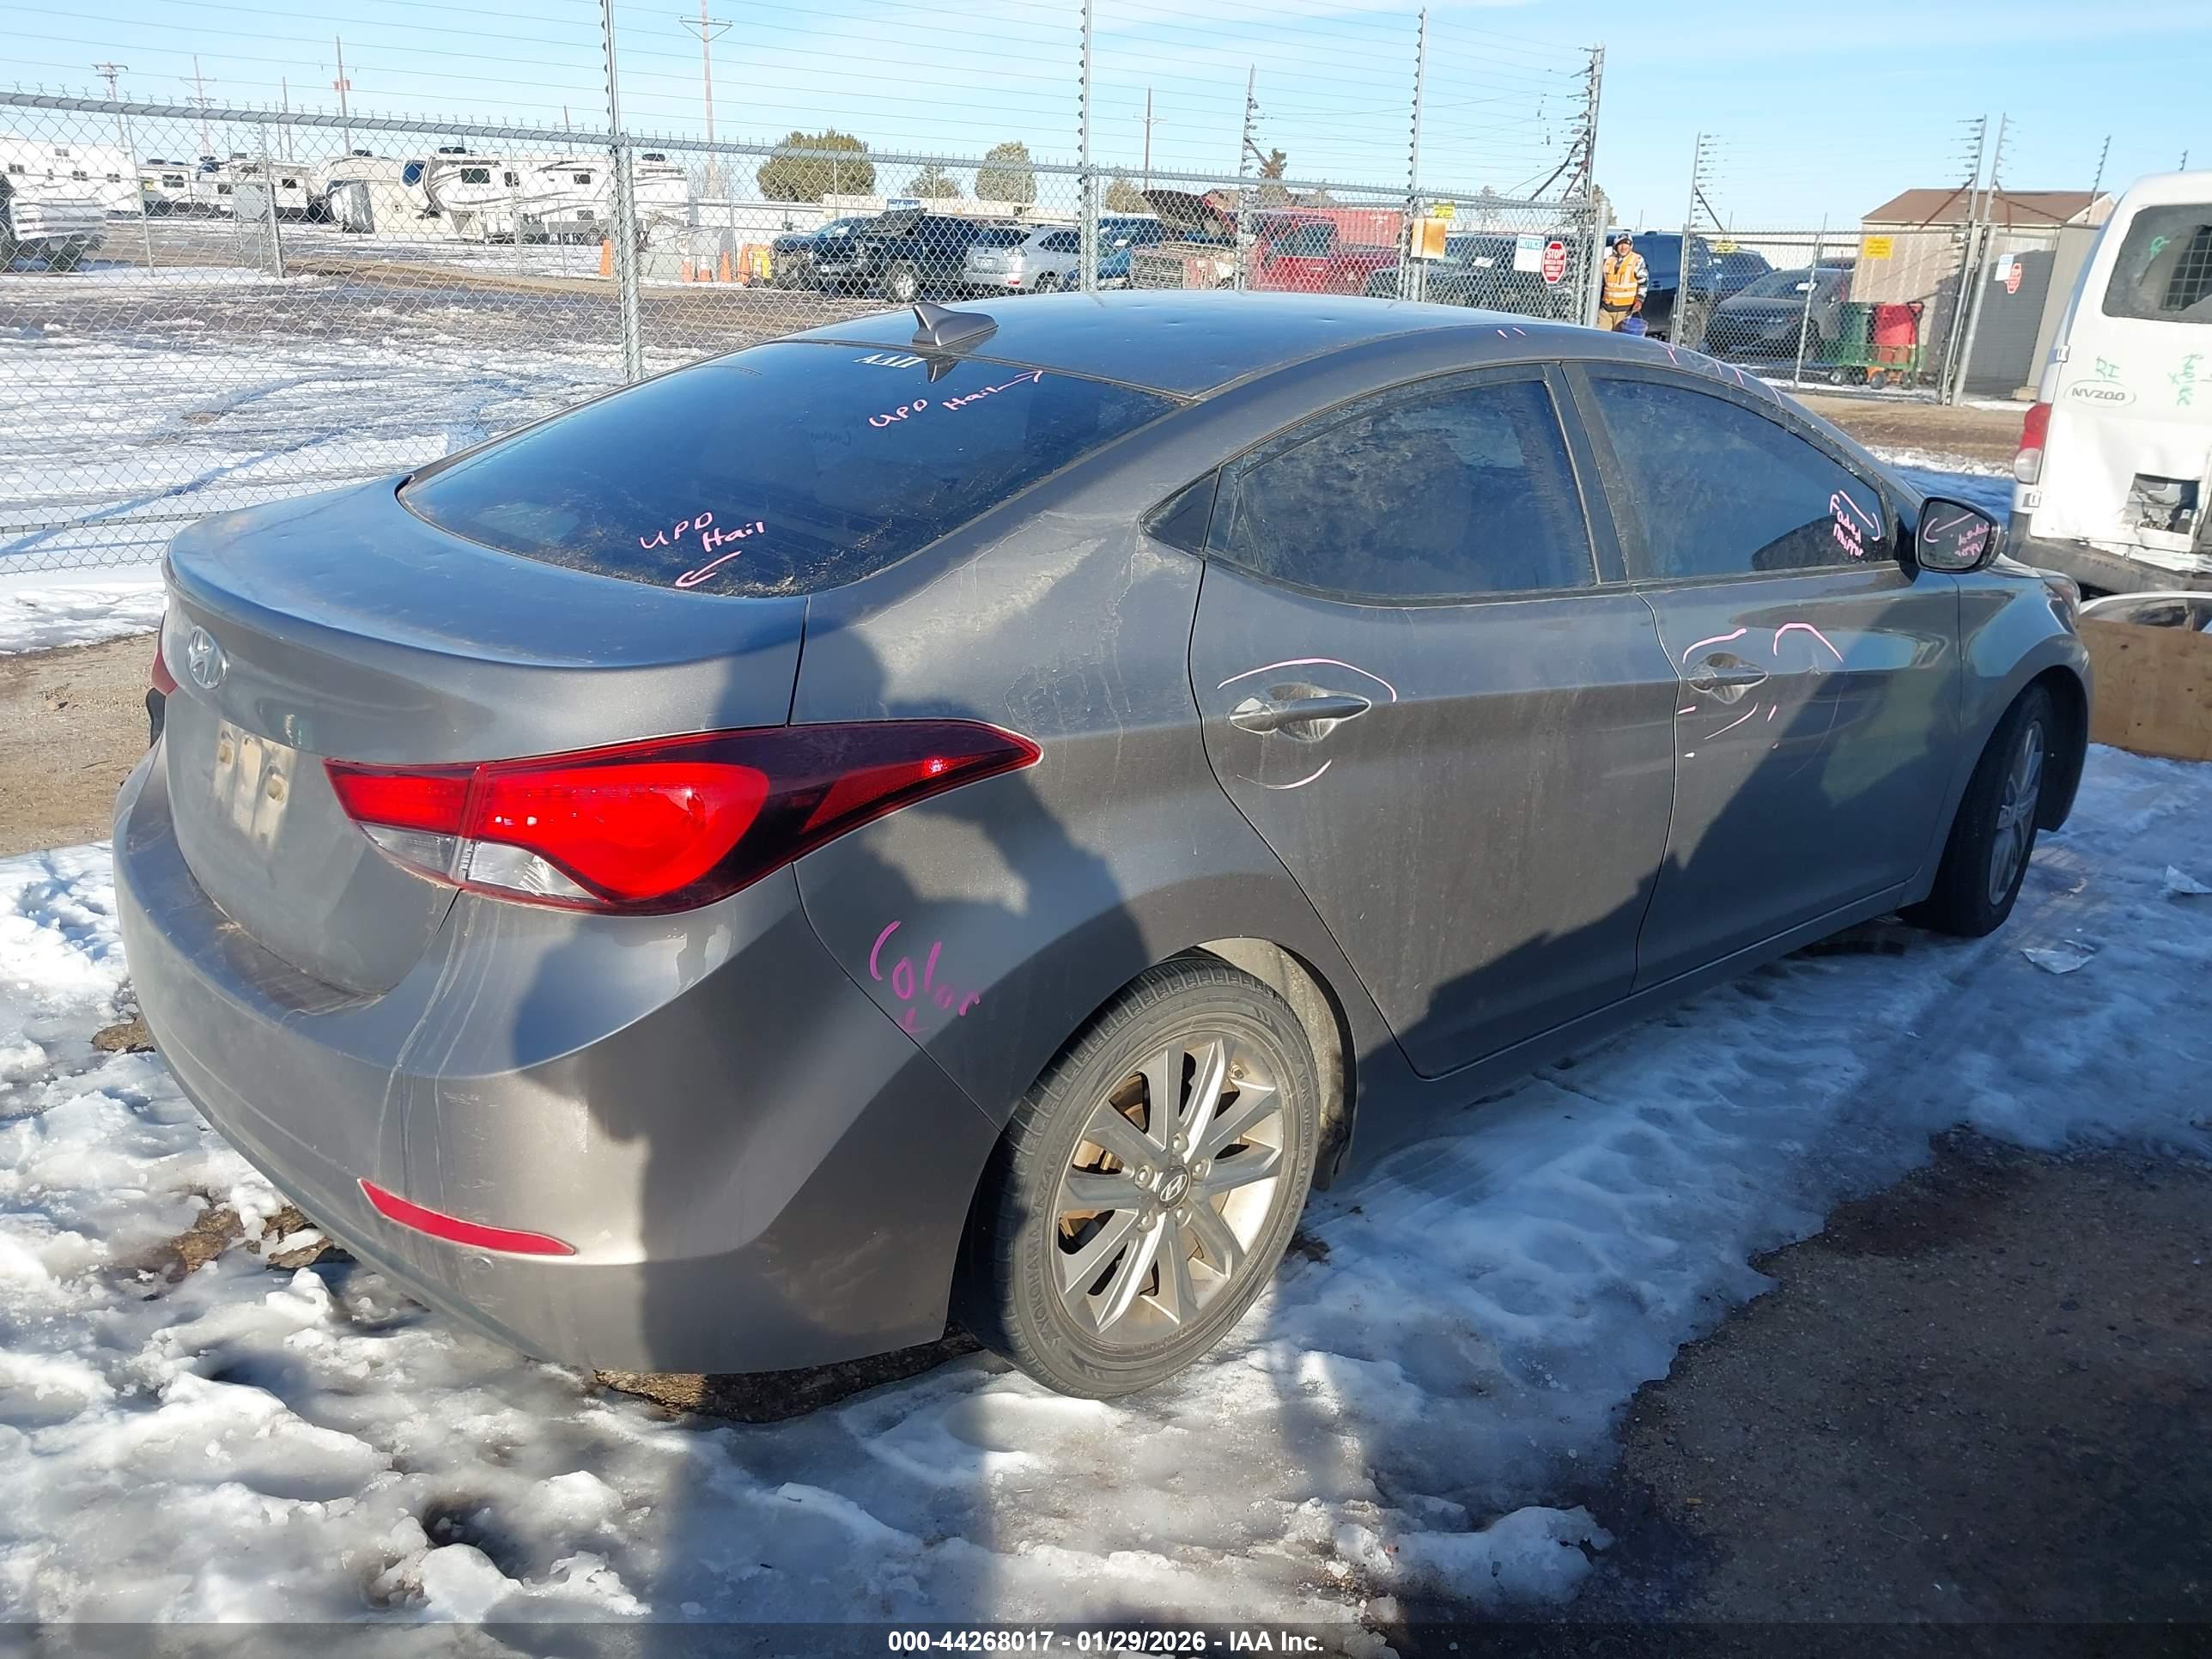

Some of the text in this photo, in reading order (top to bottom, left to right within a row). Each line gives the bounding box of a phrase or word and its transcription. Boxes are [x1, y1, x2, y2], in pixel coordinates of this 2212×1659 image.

[1517, 240, 1542, 250] NOTICE
[1546, 247, 1565, 260] STOP
[942, 386, 999, 411] Hail
[2071, 386, 2126, 402] NV200
[702, 520, 765, 553] Hail
[1297, 1071, 1315, 1161] YOKOHAMA
[1026, 1228, 1050, 1331] YOKOHAMA
